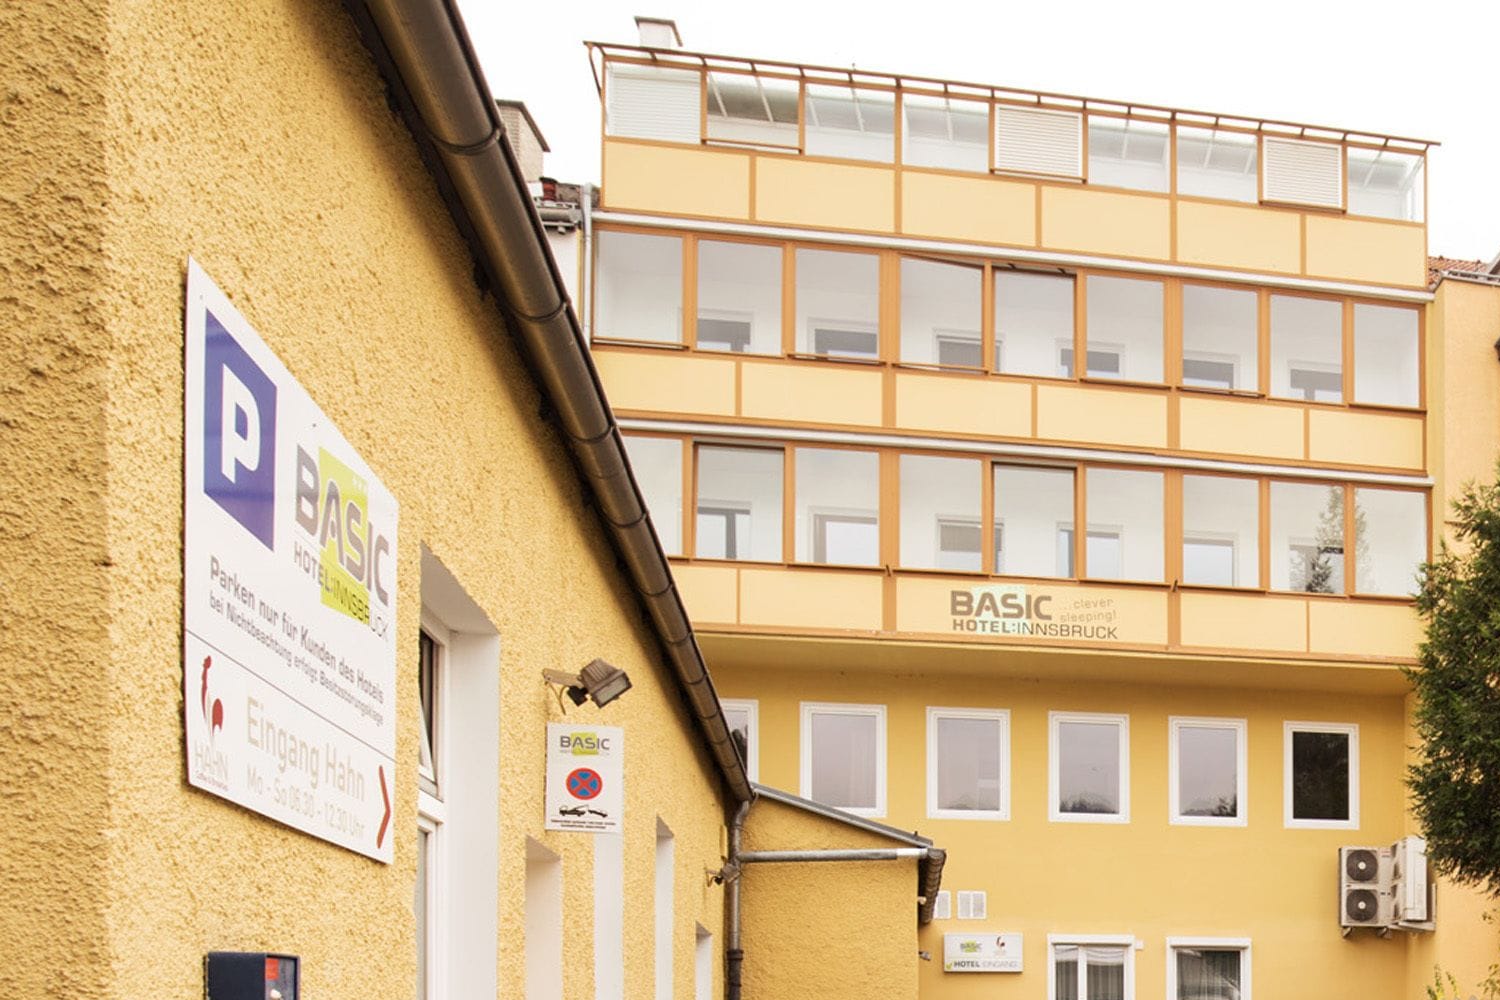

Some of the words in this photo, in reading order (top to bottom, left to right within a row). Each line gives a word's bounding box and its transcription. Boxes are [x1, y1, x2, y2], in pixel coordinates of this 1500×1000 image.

[221, 363, 261, 484] P
[295, 444, 390, 607] BASIC
[210, 590, 224, 615] bei
[951, 590, 1052, 620] BASIC
[210, 555, 255, 610] Parken
[259, 600, 279, 626] nur
[282, 612, 298, 640] für
[301, 626, 336, 671] Kunden
[339, 658, 355, 683] des
[357, 669, 384, 704] Hotels
[953, 619, 1118, 639] HOTEL:INNSBRUCK
[194, 739, 228, 782] HAHN
[247, 697, 319, 790] Eingang
[325, 742, 365, 802] Hahn
[560, 735, 611, 751] BASIC
